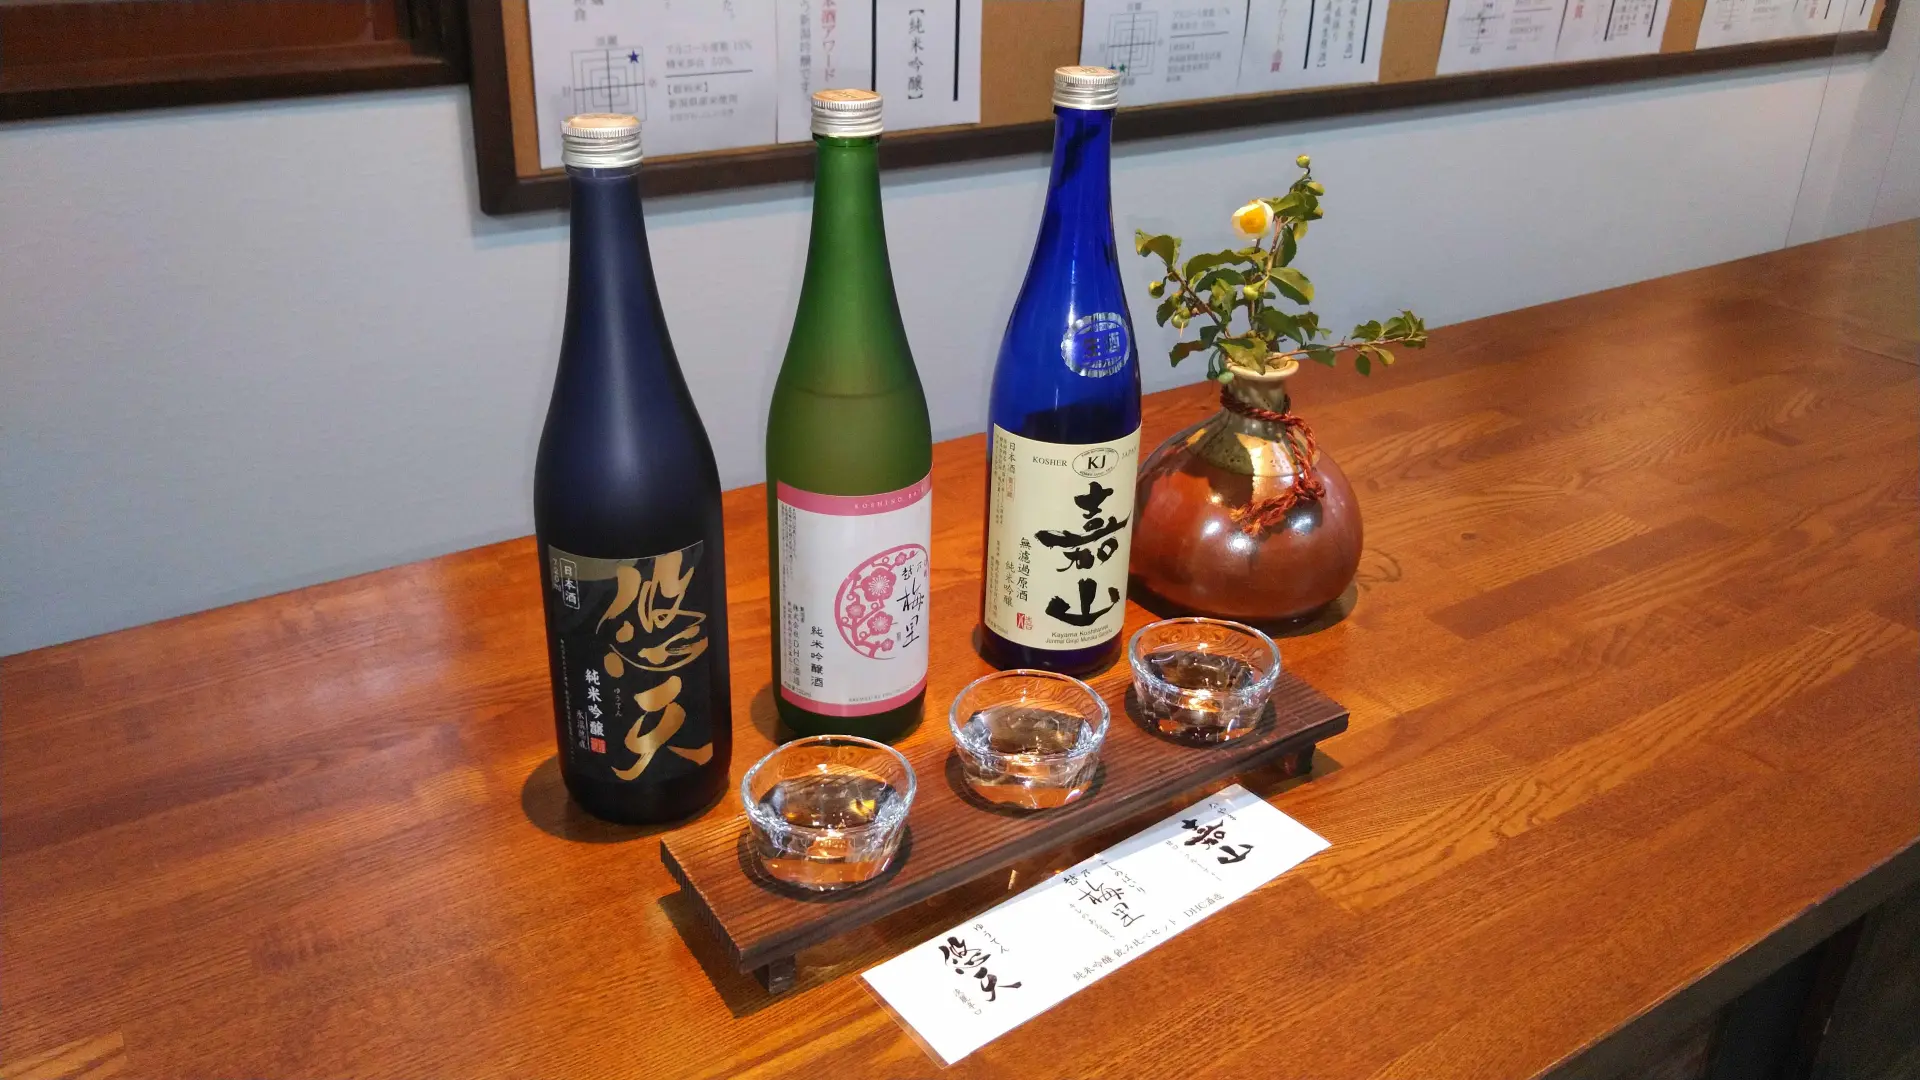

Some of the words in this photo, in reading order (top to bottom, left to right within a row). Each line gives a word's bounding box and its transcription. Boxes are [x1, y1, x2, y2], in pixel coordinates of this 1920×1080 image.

[908, 9, 924, 100] 【純米吟醸】
[1008, 442, 1016, 474] 日本酒
[1032, 456, 1068, 468] KOSHER
[1087, 454, 1106, 470] KJ
[854, 496, 903, 510] KOSHINO
[1017, 537, 1032, 602] 無濾過原酒
[1034, 481, 1133, 626] 嘉山
[563, 564, 578, 605] 日本酒
[1003, 560, 1016, 608] 純米吟醸
[596, 550, 714, 781] 悠天
[810, 625, 825, 688] 純米吟醸酒
[585, 668, 605, 737] 純米吟醸
[612, 687, 623, 718] ゆうてん
[1208, 802, 1237, 821] かやま
[1181, 818, 1254, 865] 嘉山
[1100, 859, 1148, 895] こしのばいり
[972, 923, 1010, 954] ゆうてん
[938, 936, 1023, 1002] 悠天
[1073, 954, 1114, 982] 純米吟醸
